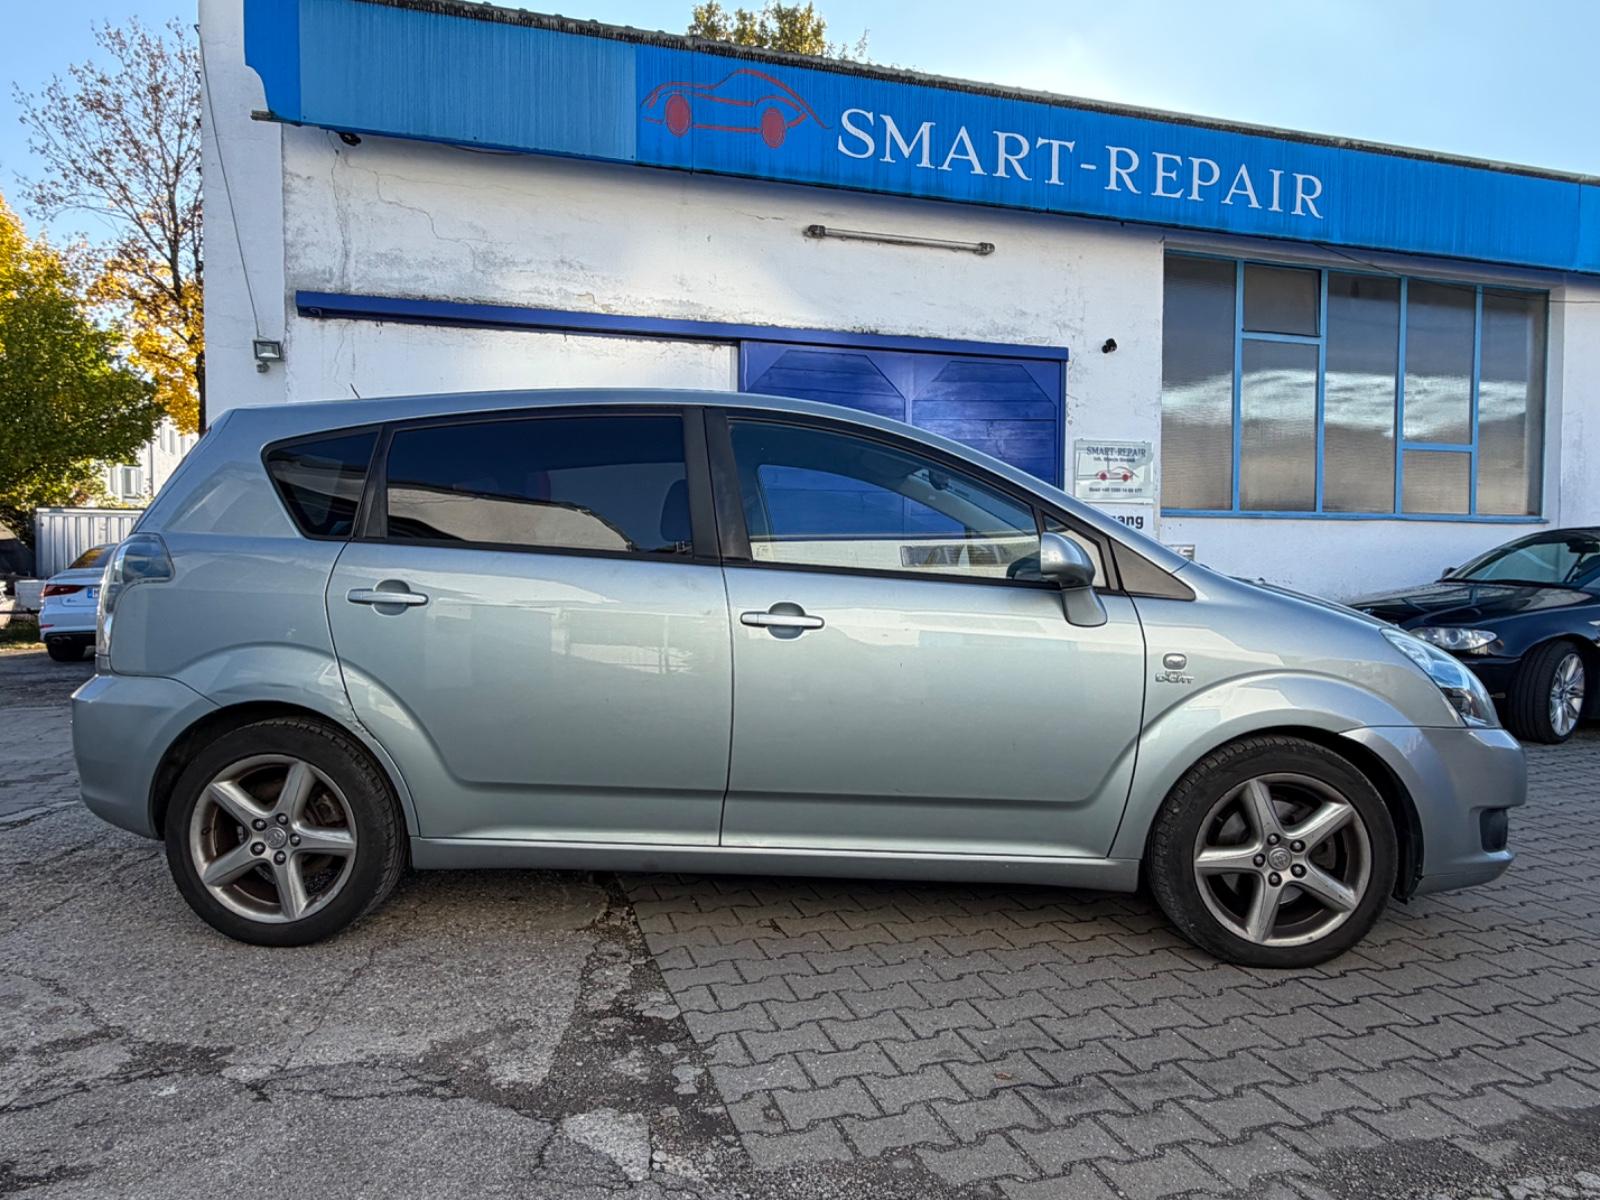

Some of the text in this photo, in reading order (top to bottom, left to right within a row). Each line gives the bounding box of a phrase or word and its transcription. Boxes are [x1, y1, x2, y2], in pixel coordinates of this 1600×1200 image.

[837, 107, 1324, 220] SMART-REPAIR
[1087, 446, 1146, 457] SMART-REPAIR
[1112, 515, 1144, 529] ang
